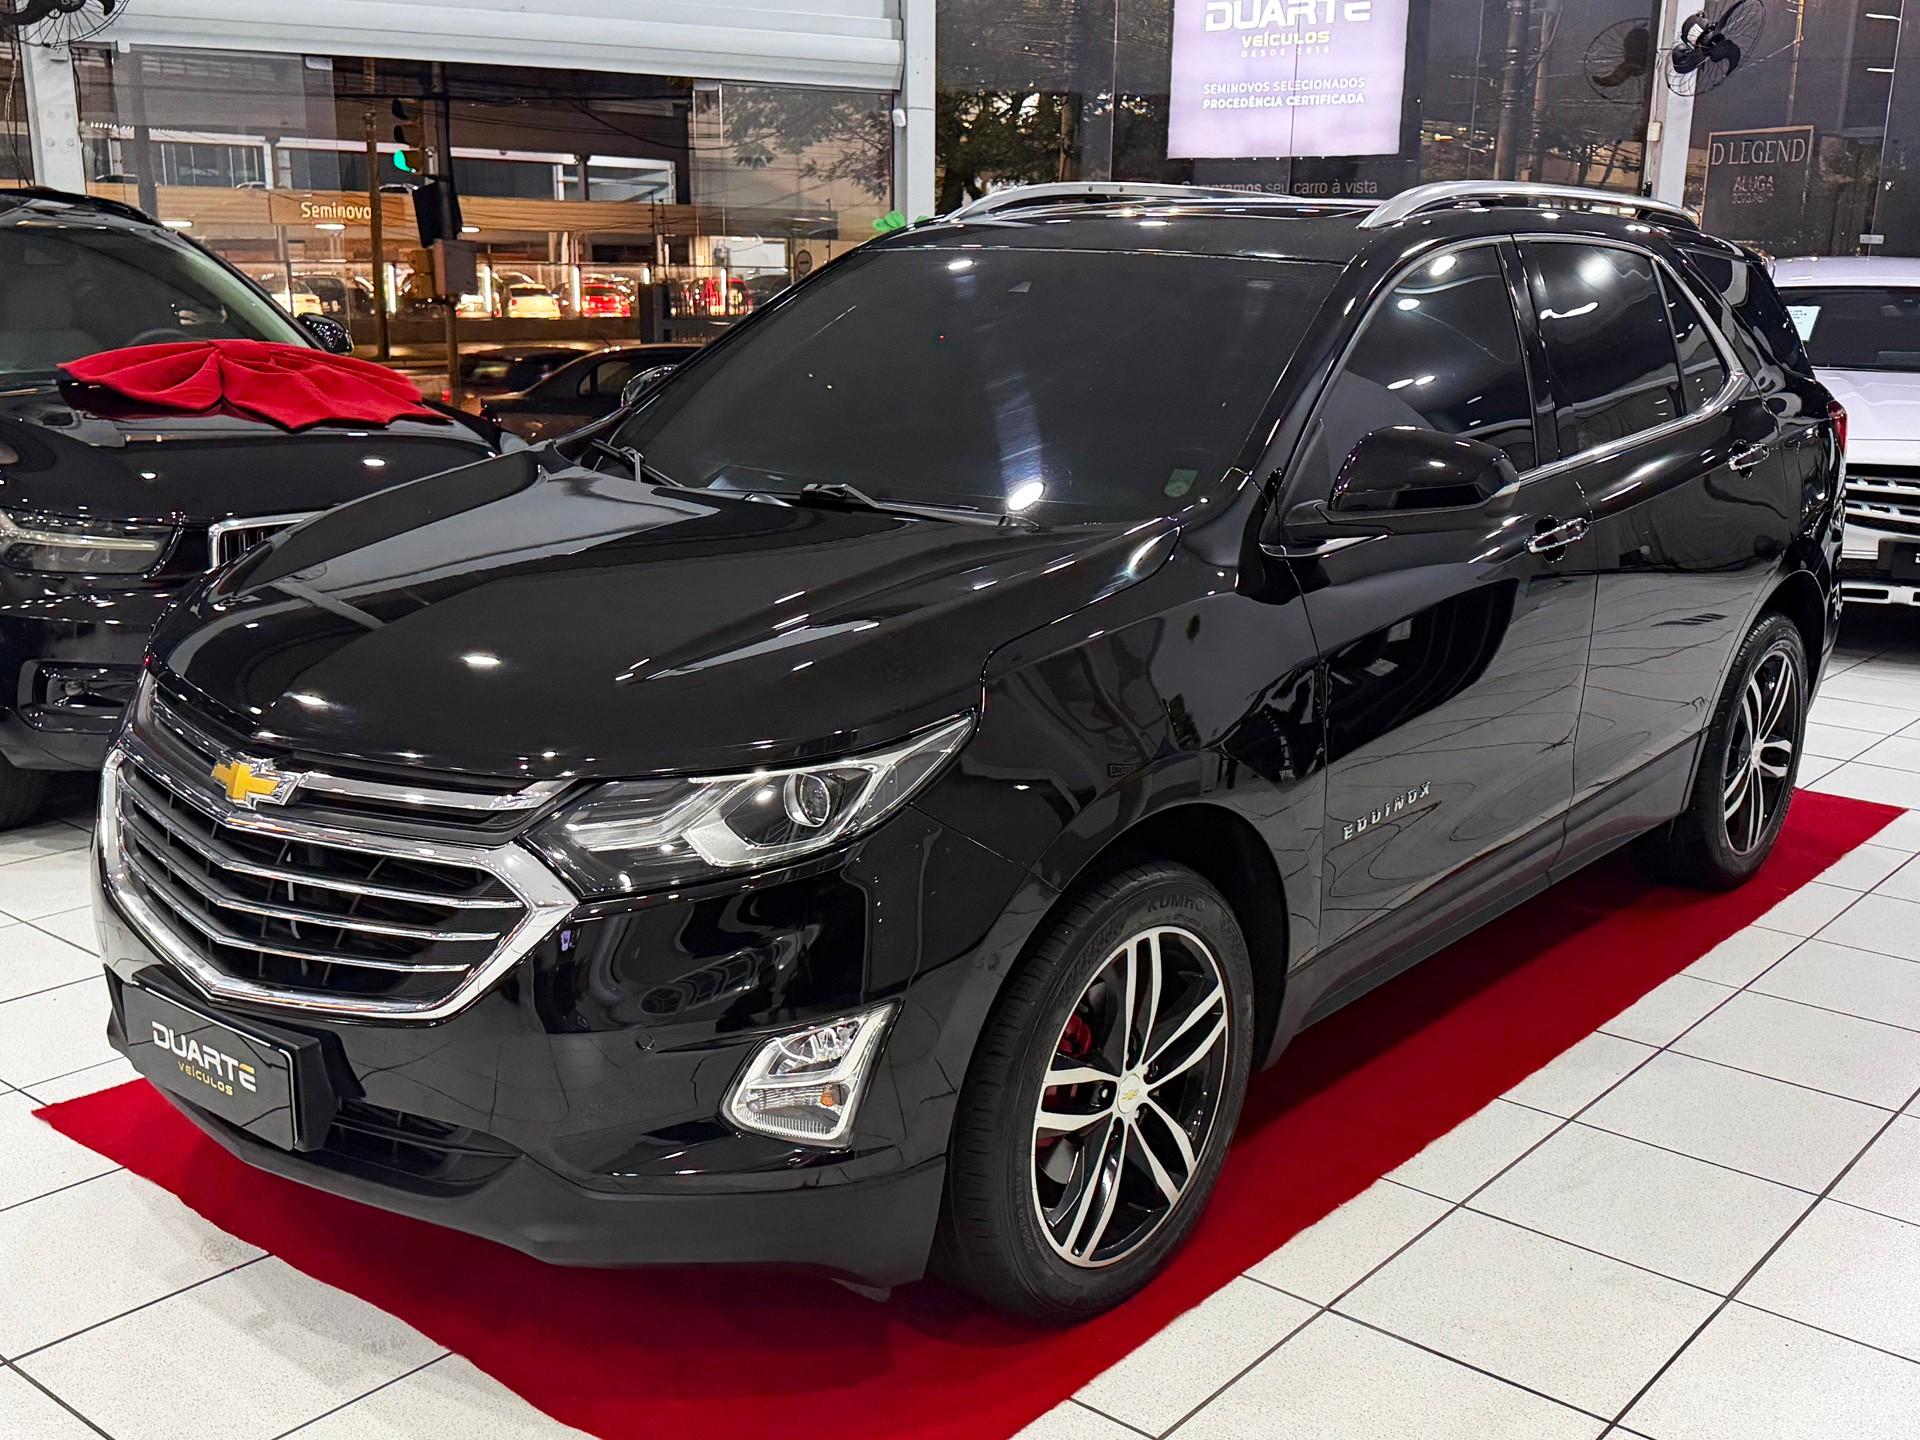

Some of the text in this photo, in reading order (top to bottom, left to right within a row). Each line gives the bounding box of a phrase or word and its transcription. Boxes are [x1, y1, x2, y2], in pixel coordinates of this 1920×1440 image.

[1205, 0, 1372, 31] DUARTE
[1203, 77, 1365, 94] SEMINOVOS SELECIONADOS
[1203, 93, 1364, 109] PROCEDÊNCIA CERTIFICADA
[1711, 138, 1806, 165] D LEGEND
[1266, 183, 1290, 194] seu
[1294, 180, 1328, 194] carro
[1346, 179, 1378, 194] vista
[1343, 781, 1431, 840] EQUINOX
[151, 1021, 257, 1092] DUARTE
